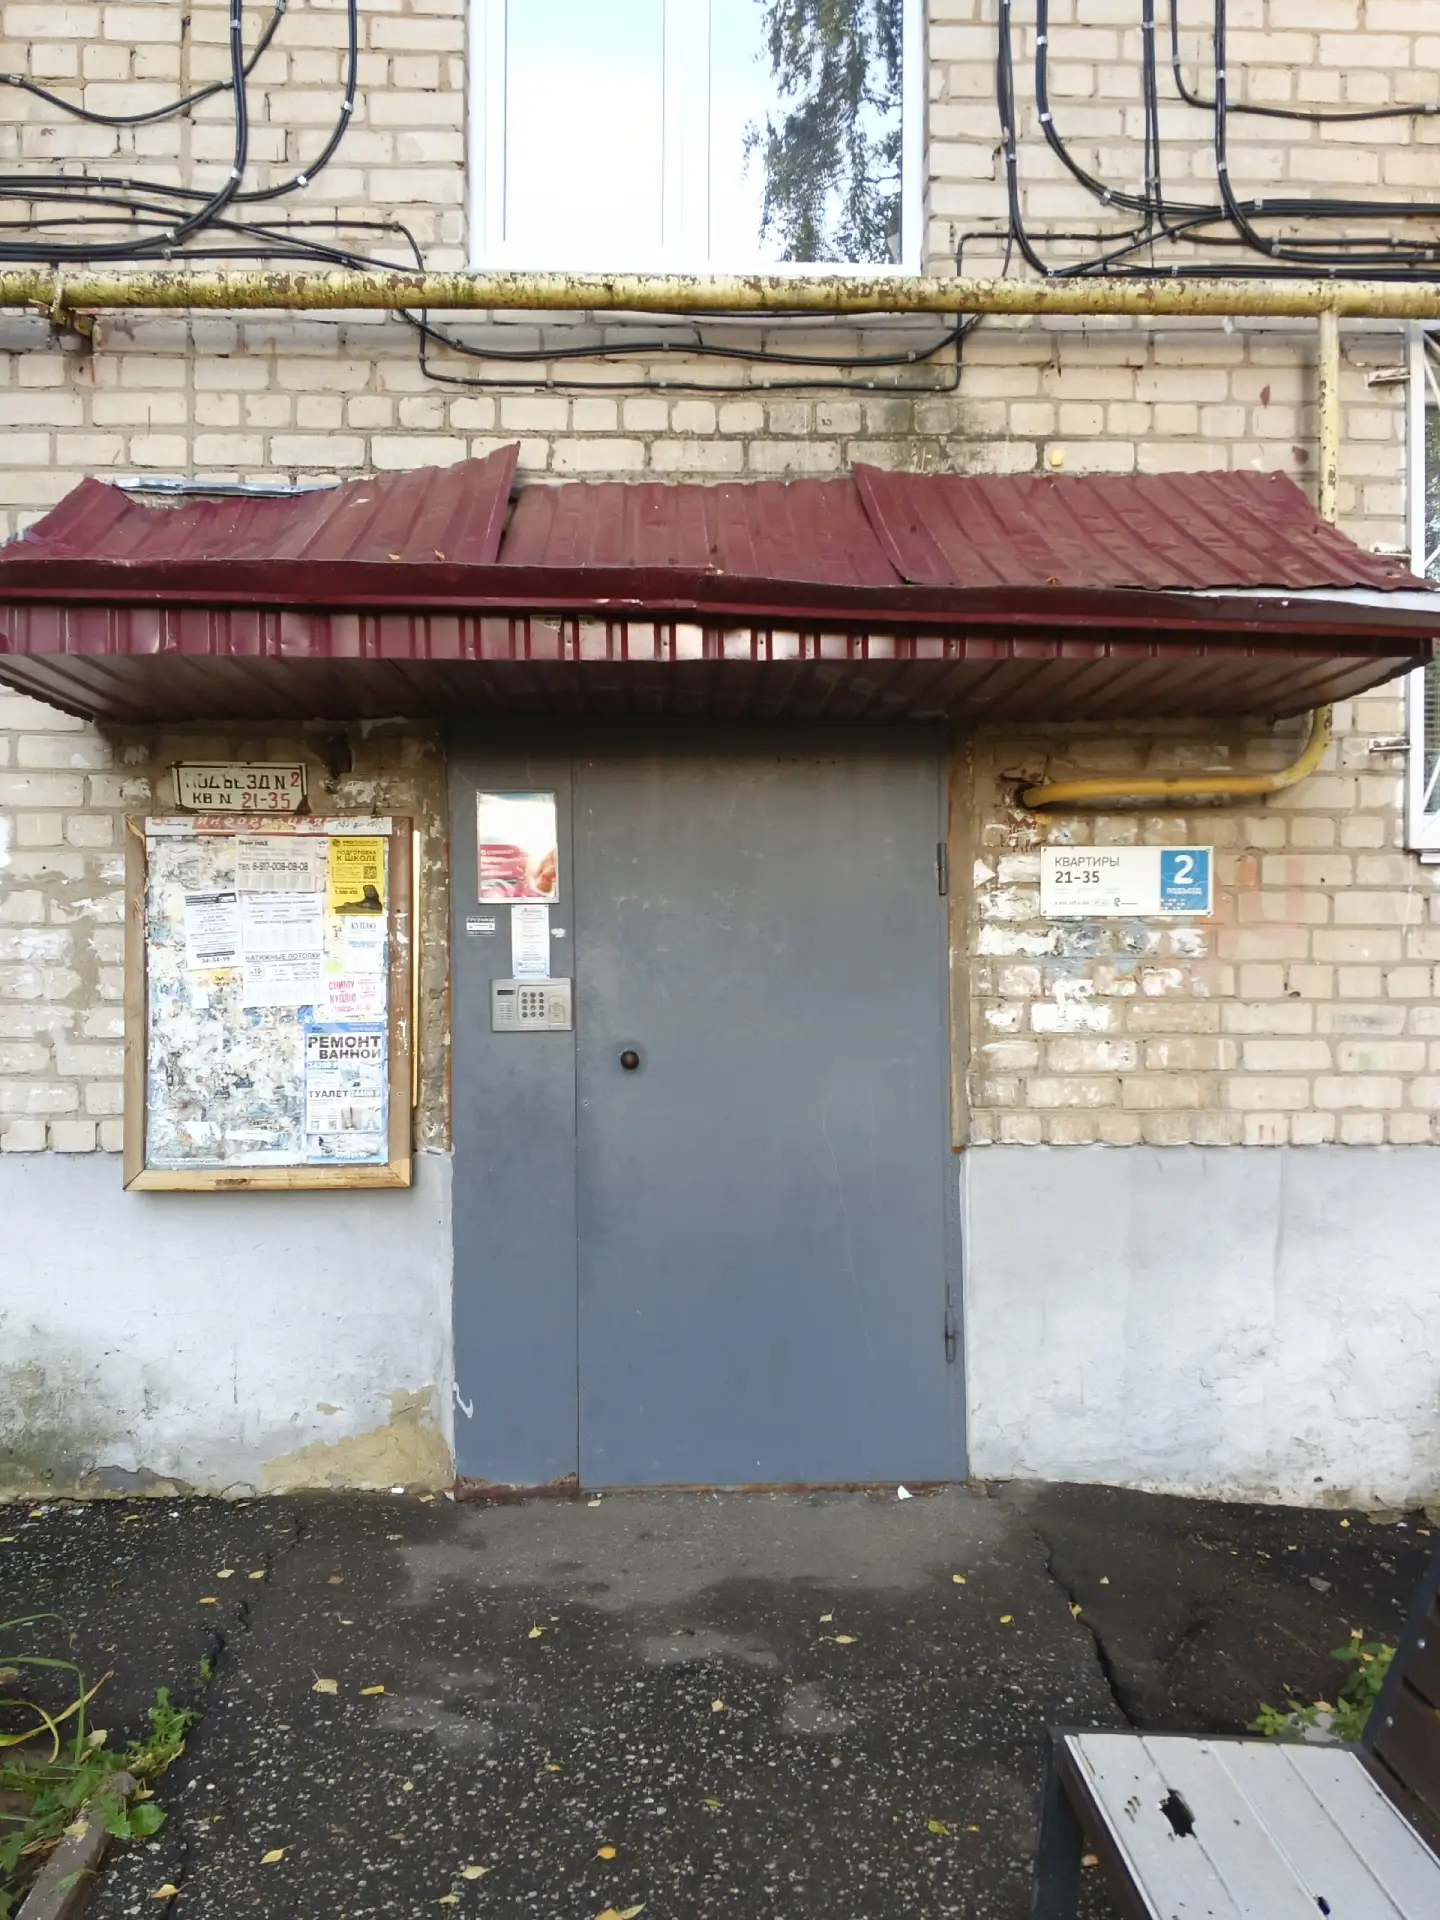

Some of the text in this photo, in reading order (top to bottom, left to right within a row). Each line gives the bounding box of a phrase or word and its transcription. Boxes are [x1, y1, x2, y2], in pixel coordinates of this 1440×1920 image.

[290, 771, 300, 787] 2
[192, 792, 213, 804] КВ
[241, 791, 290, 809] 21-35
[1054, 856, 1120, 867] КВАРТИРЫ
[1173, 854, 1195, 885] 2
[1054, 870, 1100, 884] 21-35
[308, 1035, 381, 1049] РЕМОНТ
[308, 1090, 349, 1098] ТУАЛЕТ
